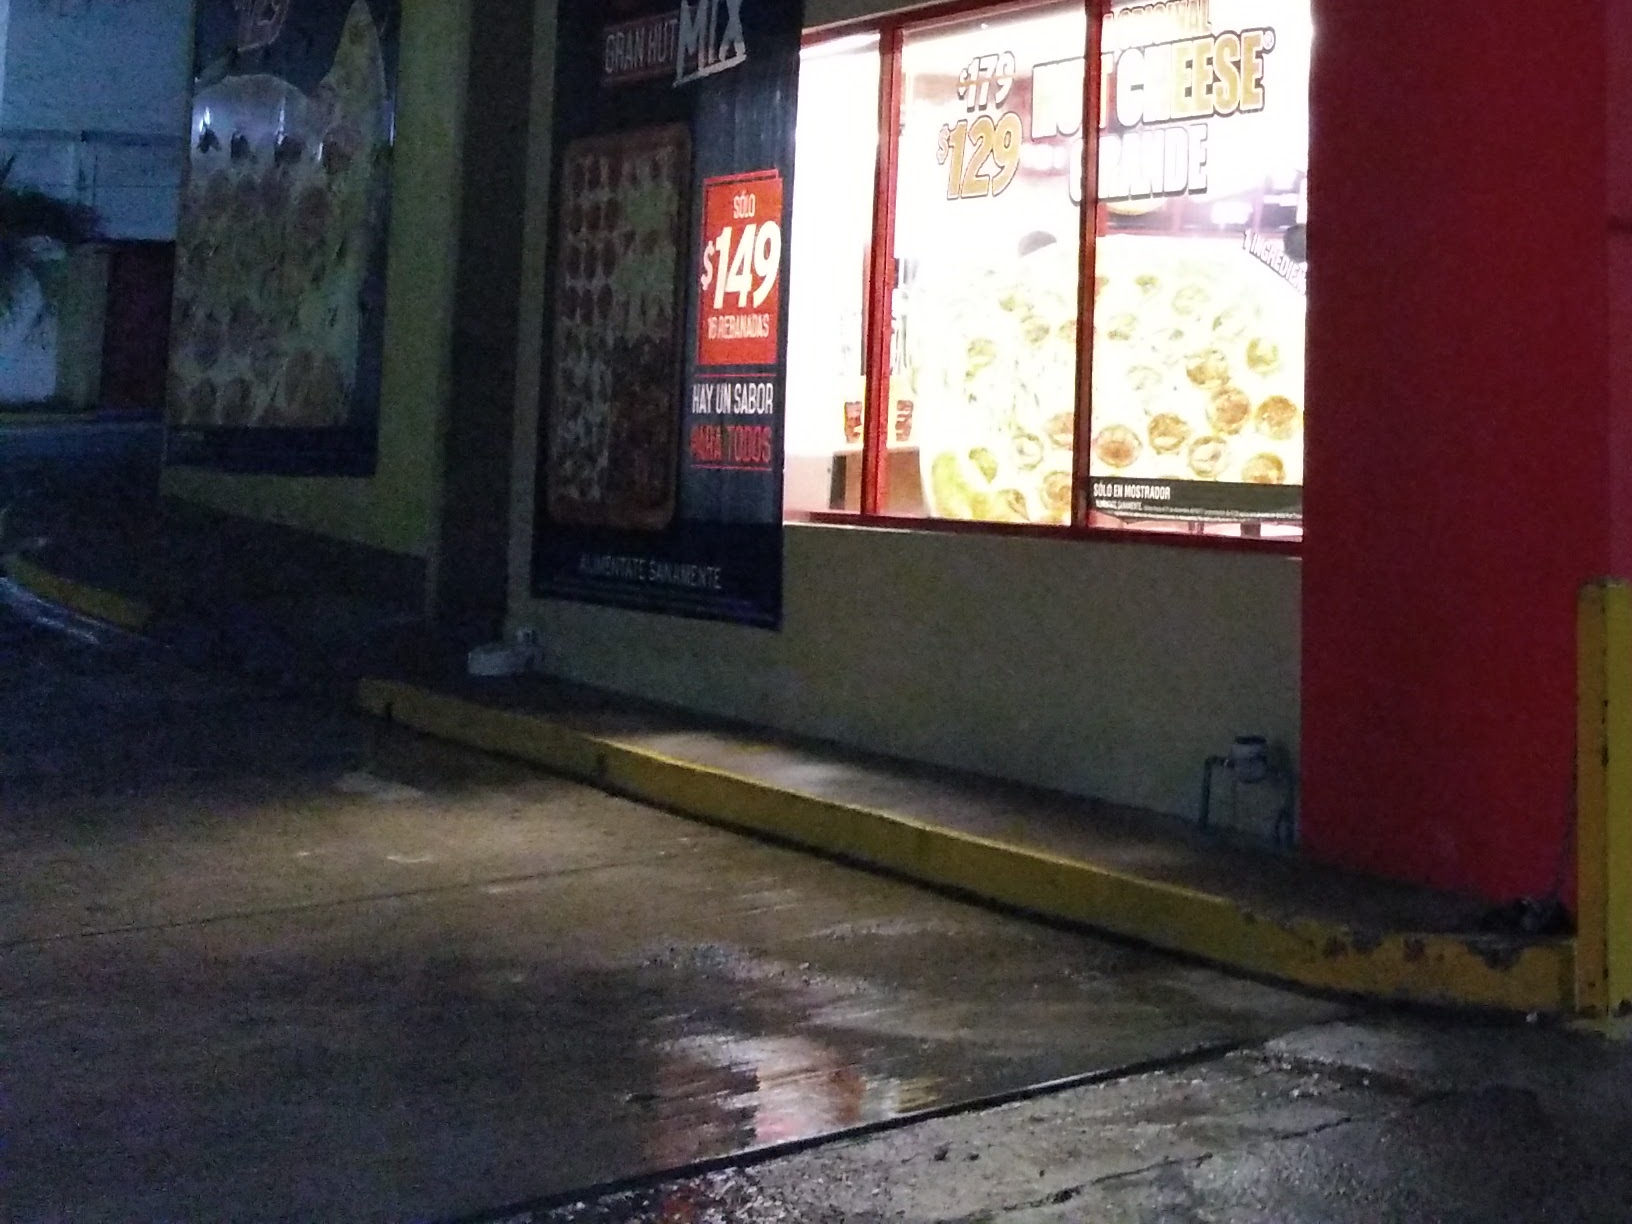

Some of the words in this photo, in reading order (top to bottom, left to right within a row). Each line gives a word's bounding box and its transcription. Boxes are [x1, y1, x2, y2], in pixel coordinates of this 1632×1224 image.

[604, 26, 647, 74] GRAN
[936, 111, 1024, 201] $129
[701, 220, 782, 309] $149
[692, 384, 715, 414] HAY
[715, 383, 732, 414] UN
[733, 382, 774, 415] SABOR
[1113, 484, 1124, 498] EN
[1124, 484, 1171, 501] MOSTRADOR
